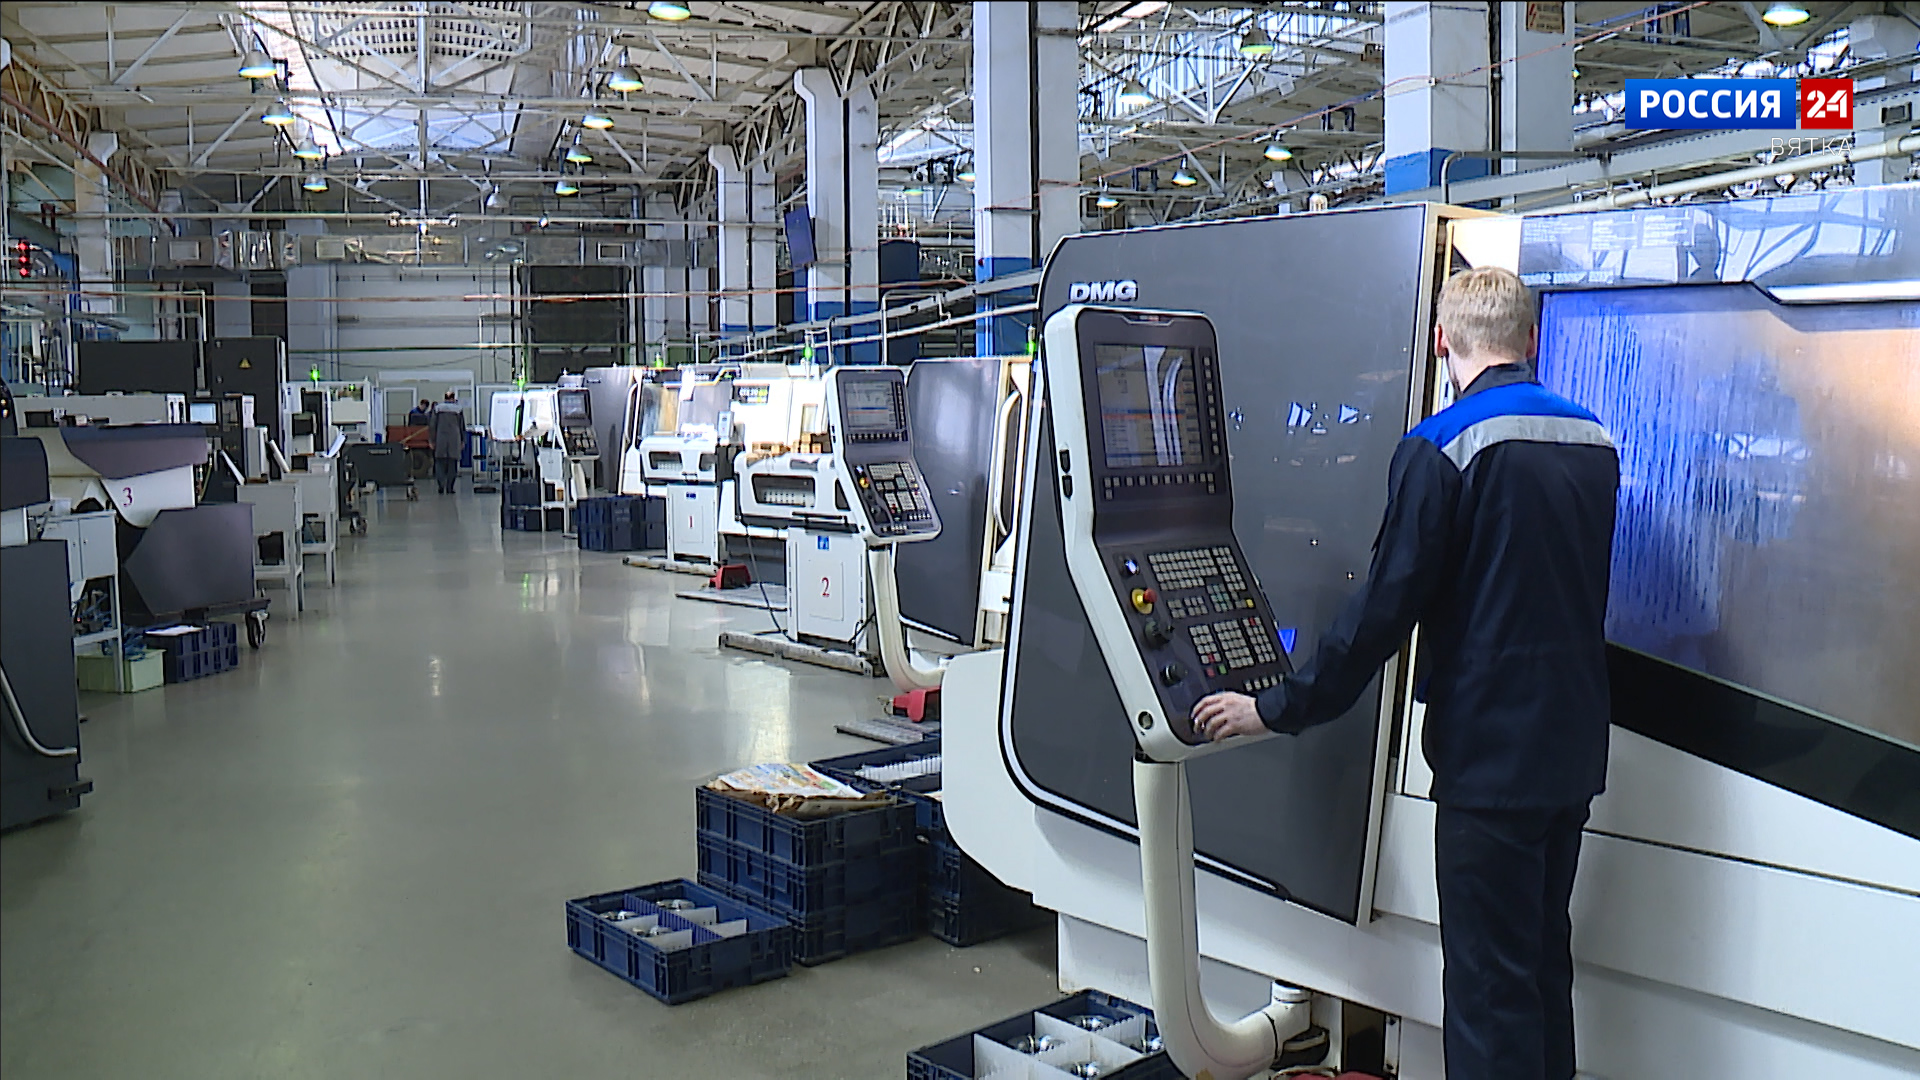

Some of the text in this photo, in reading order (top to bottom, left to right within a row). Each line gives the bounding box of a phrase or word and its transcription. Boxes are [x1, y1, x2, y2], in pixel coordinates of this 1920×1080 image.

[1069, 280, 1137, 302] DMG
[122, 486, 133, 507] 3
[821, 576, 830, 598] 2
